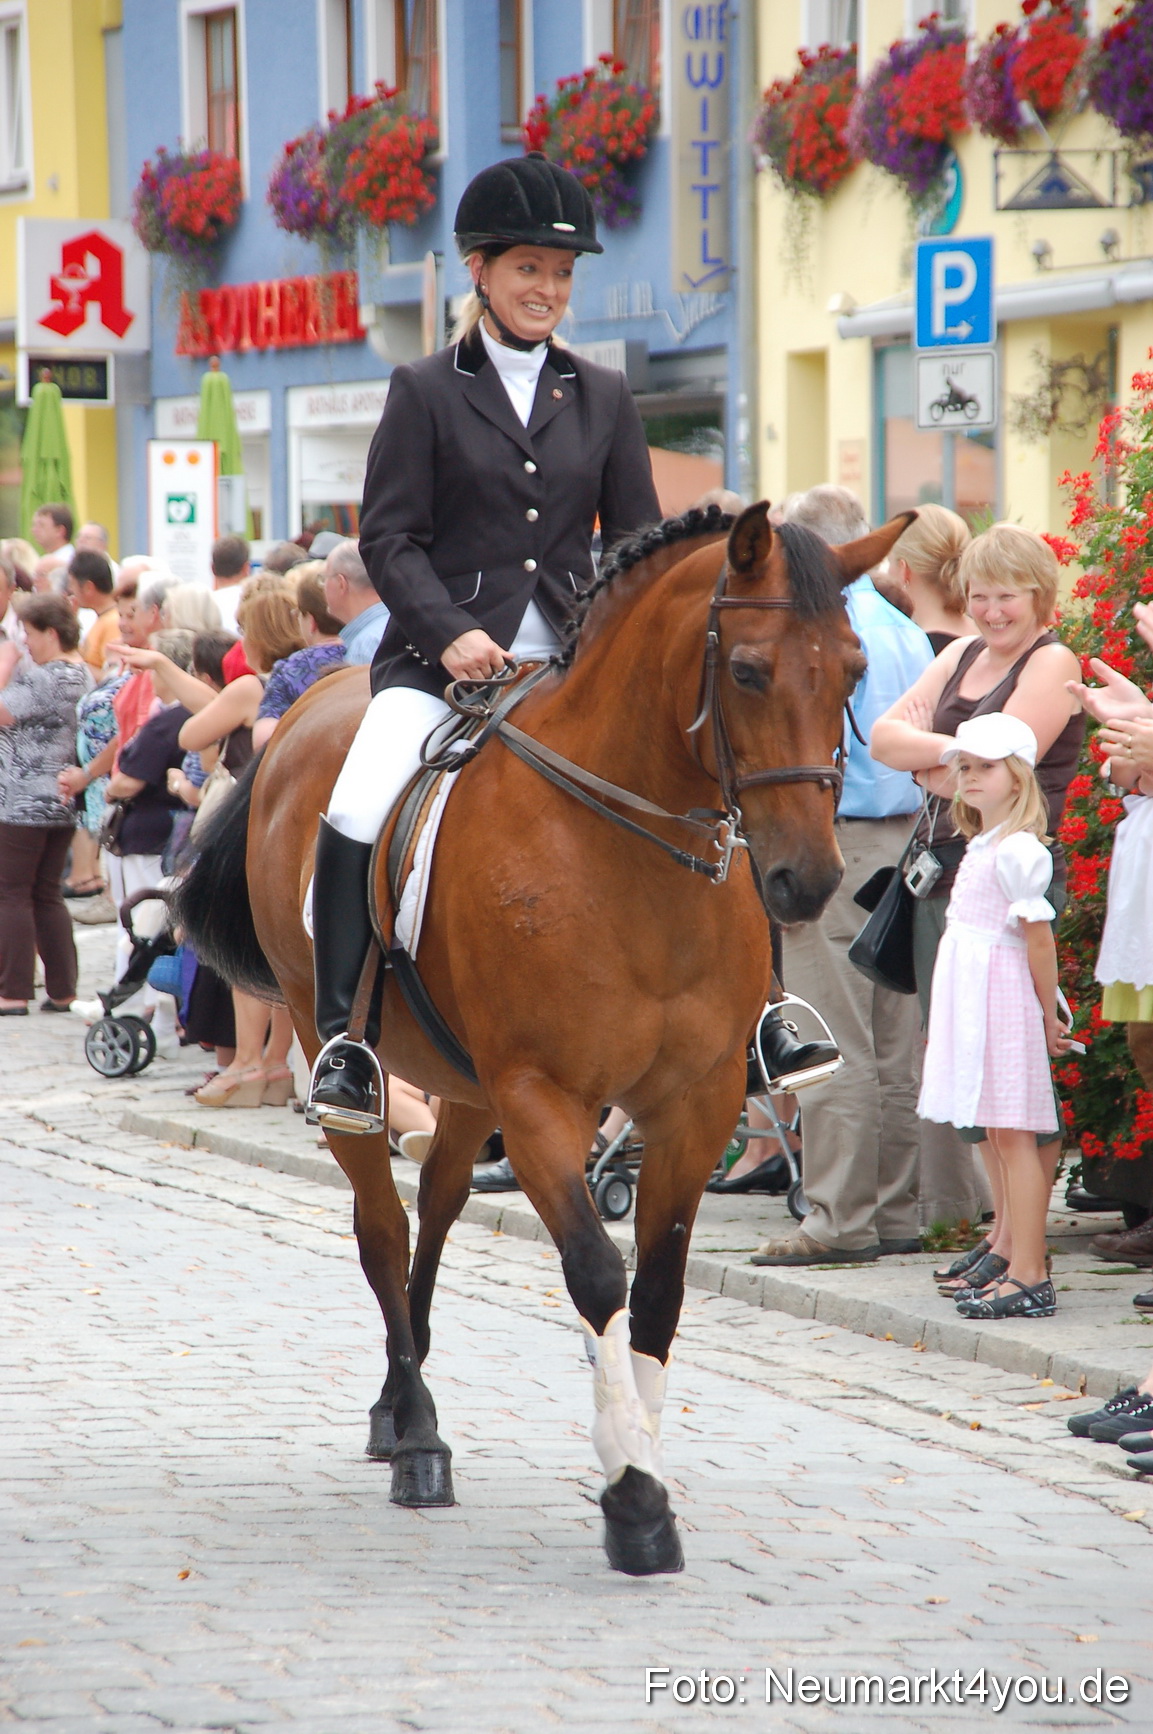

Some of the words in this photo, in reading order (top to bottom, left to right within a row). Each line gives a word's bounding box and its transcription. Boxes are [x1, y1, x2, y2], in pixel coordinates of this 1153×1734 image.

[686, 52, 724, 264] WITTL
[932, 250, 977, 338] P
[942, 362, 966, 375] nur
